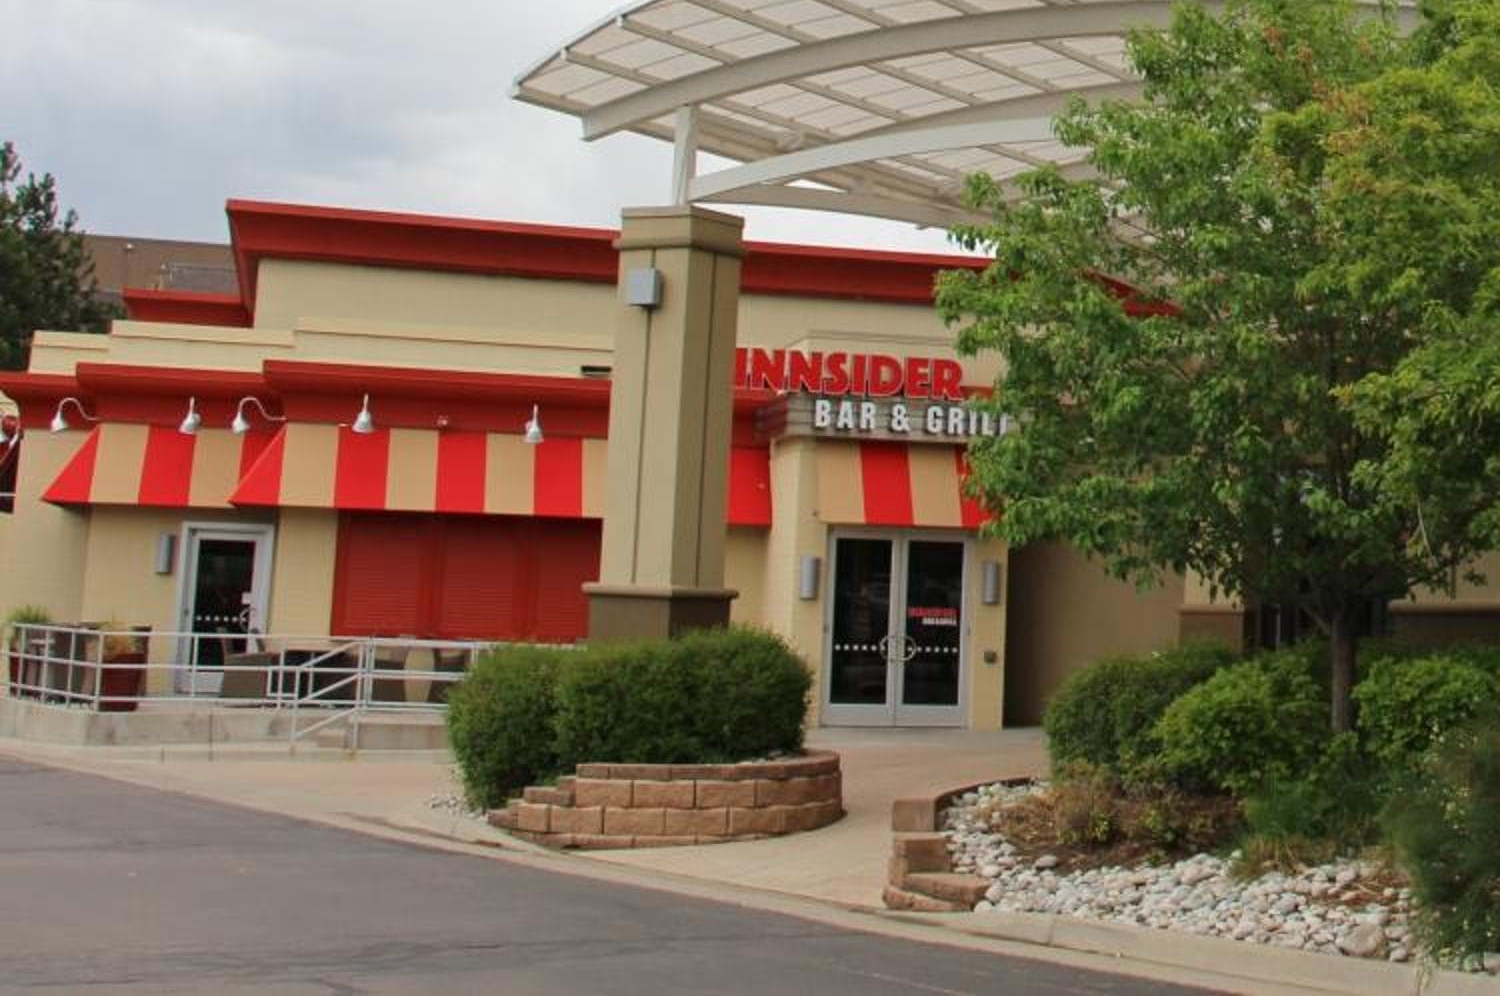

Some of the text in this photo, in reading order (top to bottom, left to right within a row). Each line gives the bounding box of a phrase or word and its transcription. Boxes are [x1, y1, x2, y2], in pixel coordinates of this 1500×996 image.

[735, 347, 965, 401] INNSIDER
[814, 400, 876, 430] BAR
[890, 404, 911, 432] &
